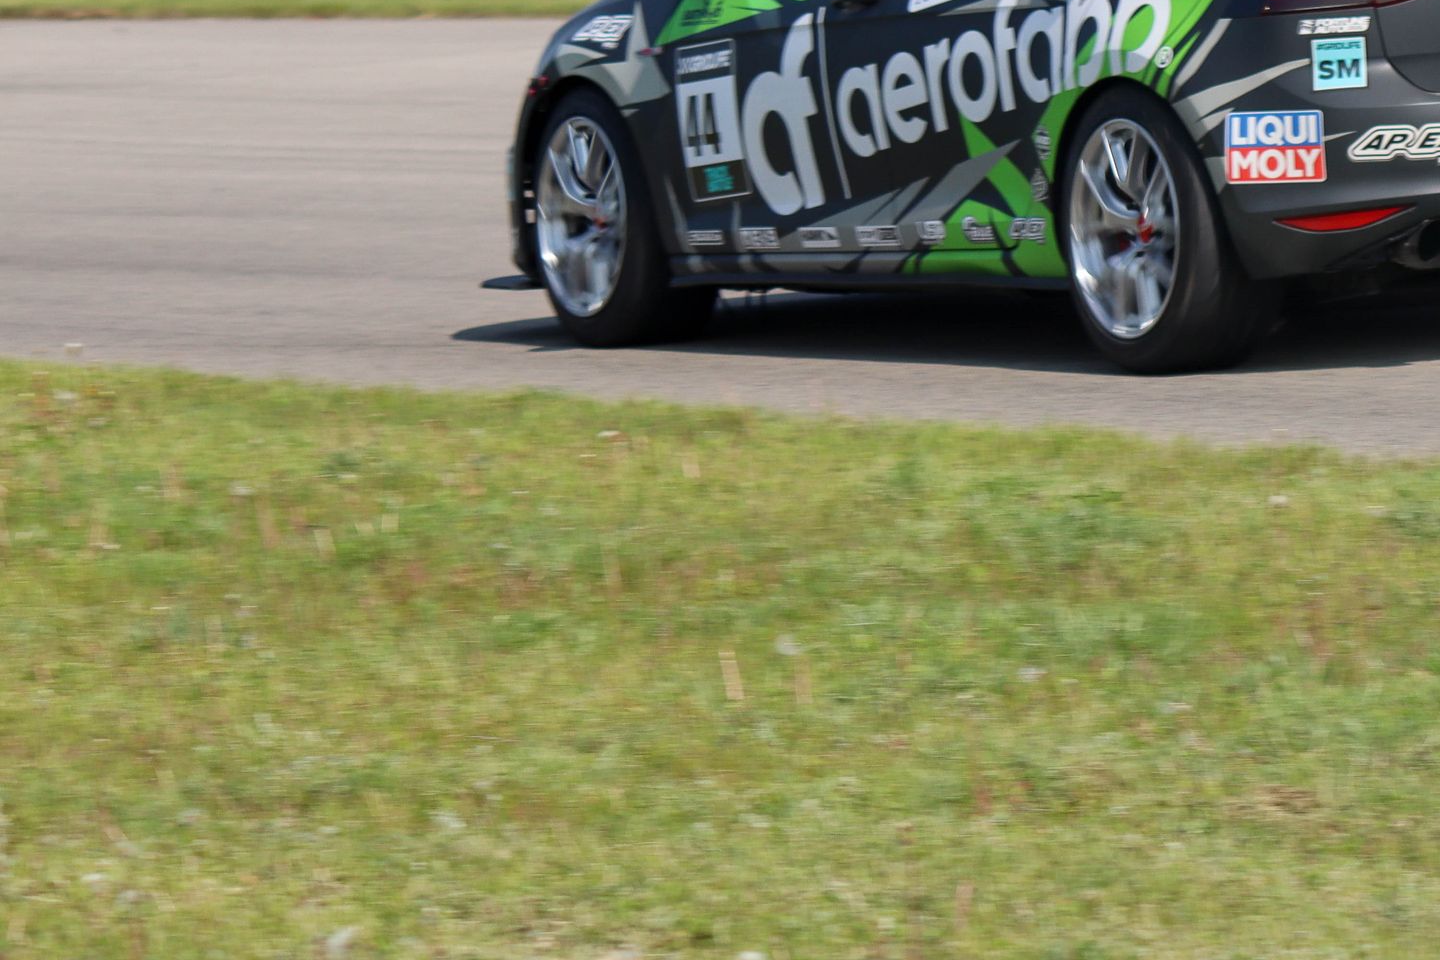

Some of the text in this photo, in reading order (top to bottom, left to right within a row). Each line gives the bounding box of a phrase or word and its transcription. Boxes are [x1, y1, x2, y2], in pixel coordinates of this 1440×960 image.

[1318, 58, 1362, 80] SM
[1230, 114, 1318, 146] LIQUI
[1230, 148, 1322, 180] MOLY
